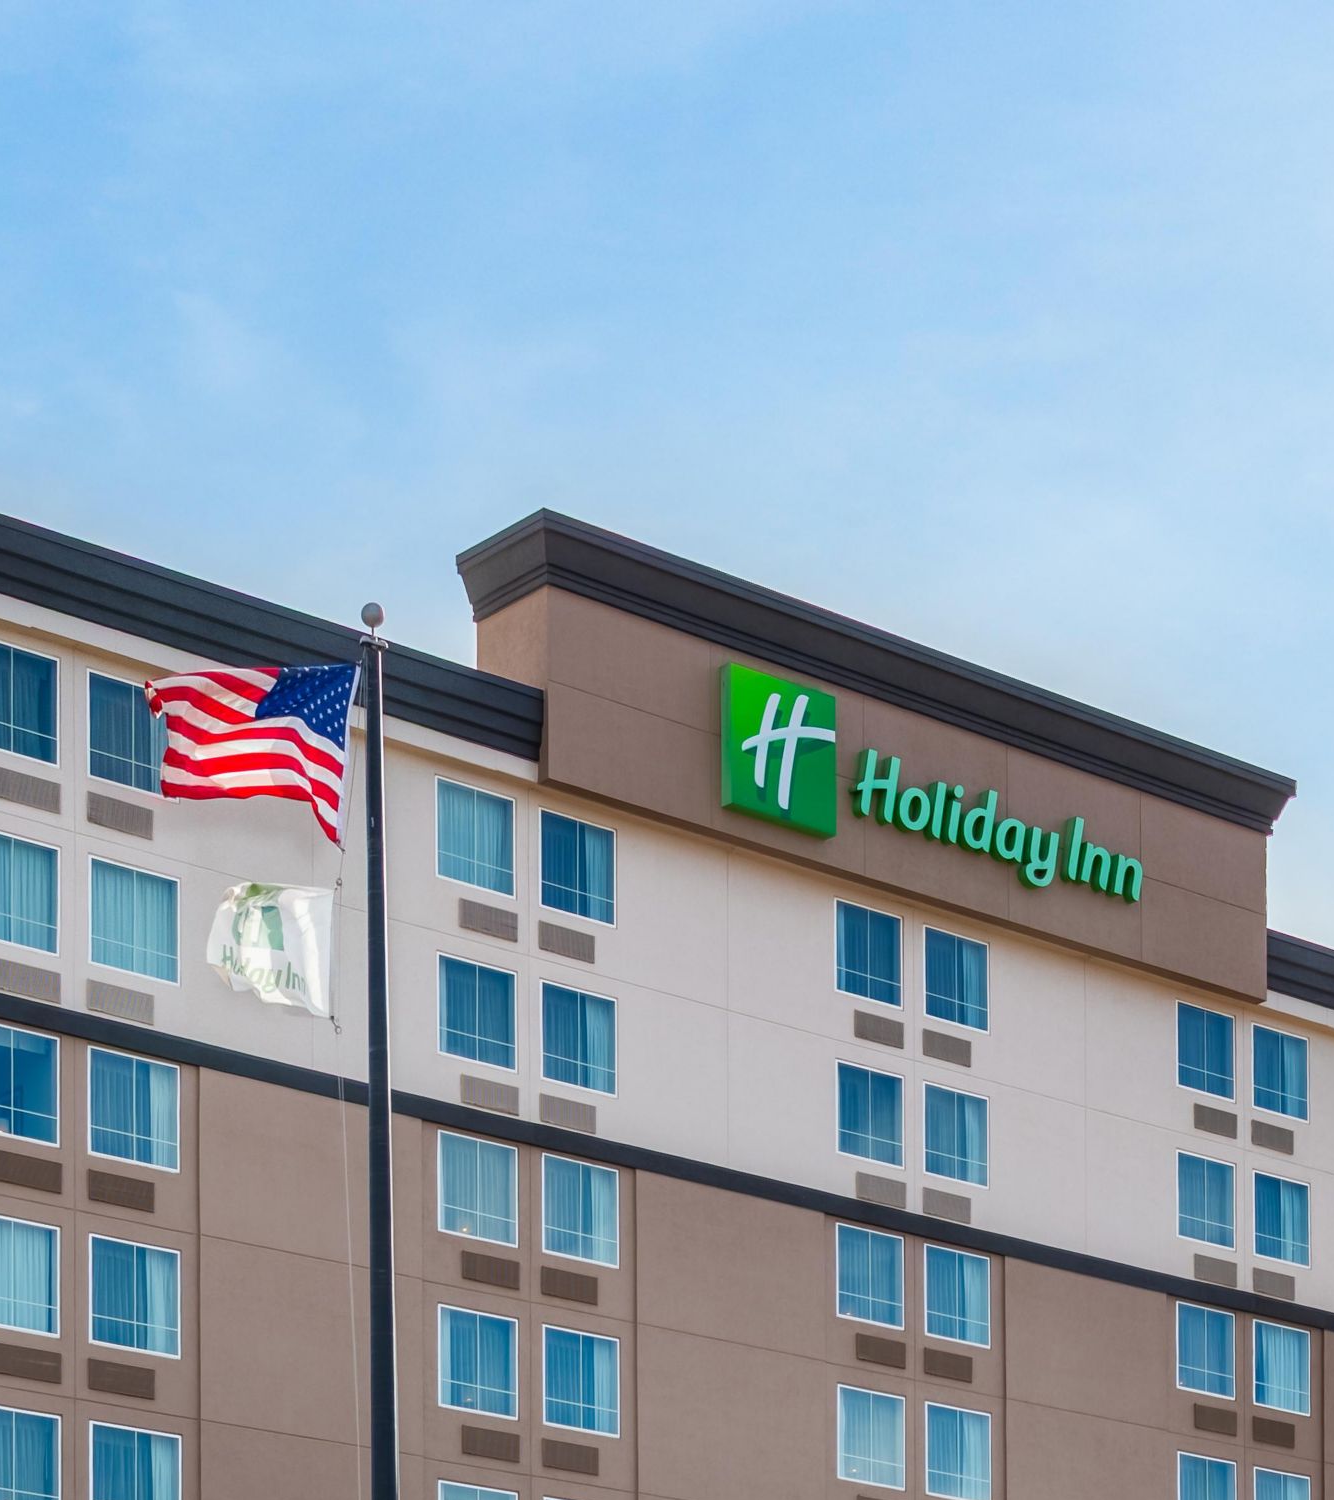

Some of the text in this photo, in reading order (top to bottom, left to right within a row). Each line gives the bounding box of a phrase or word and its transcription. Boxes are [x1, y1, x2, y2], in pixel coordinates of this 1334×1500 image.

[741, 692, 836, 811] H
[854, 748, 1144, 903] Holiday Inn
